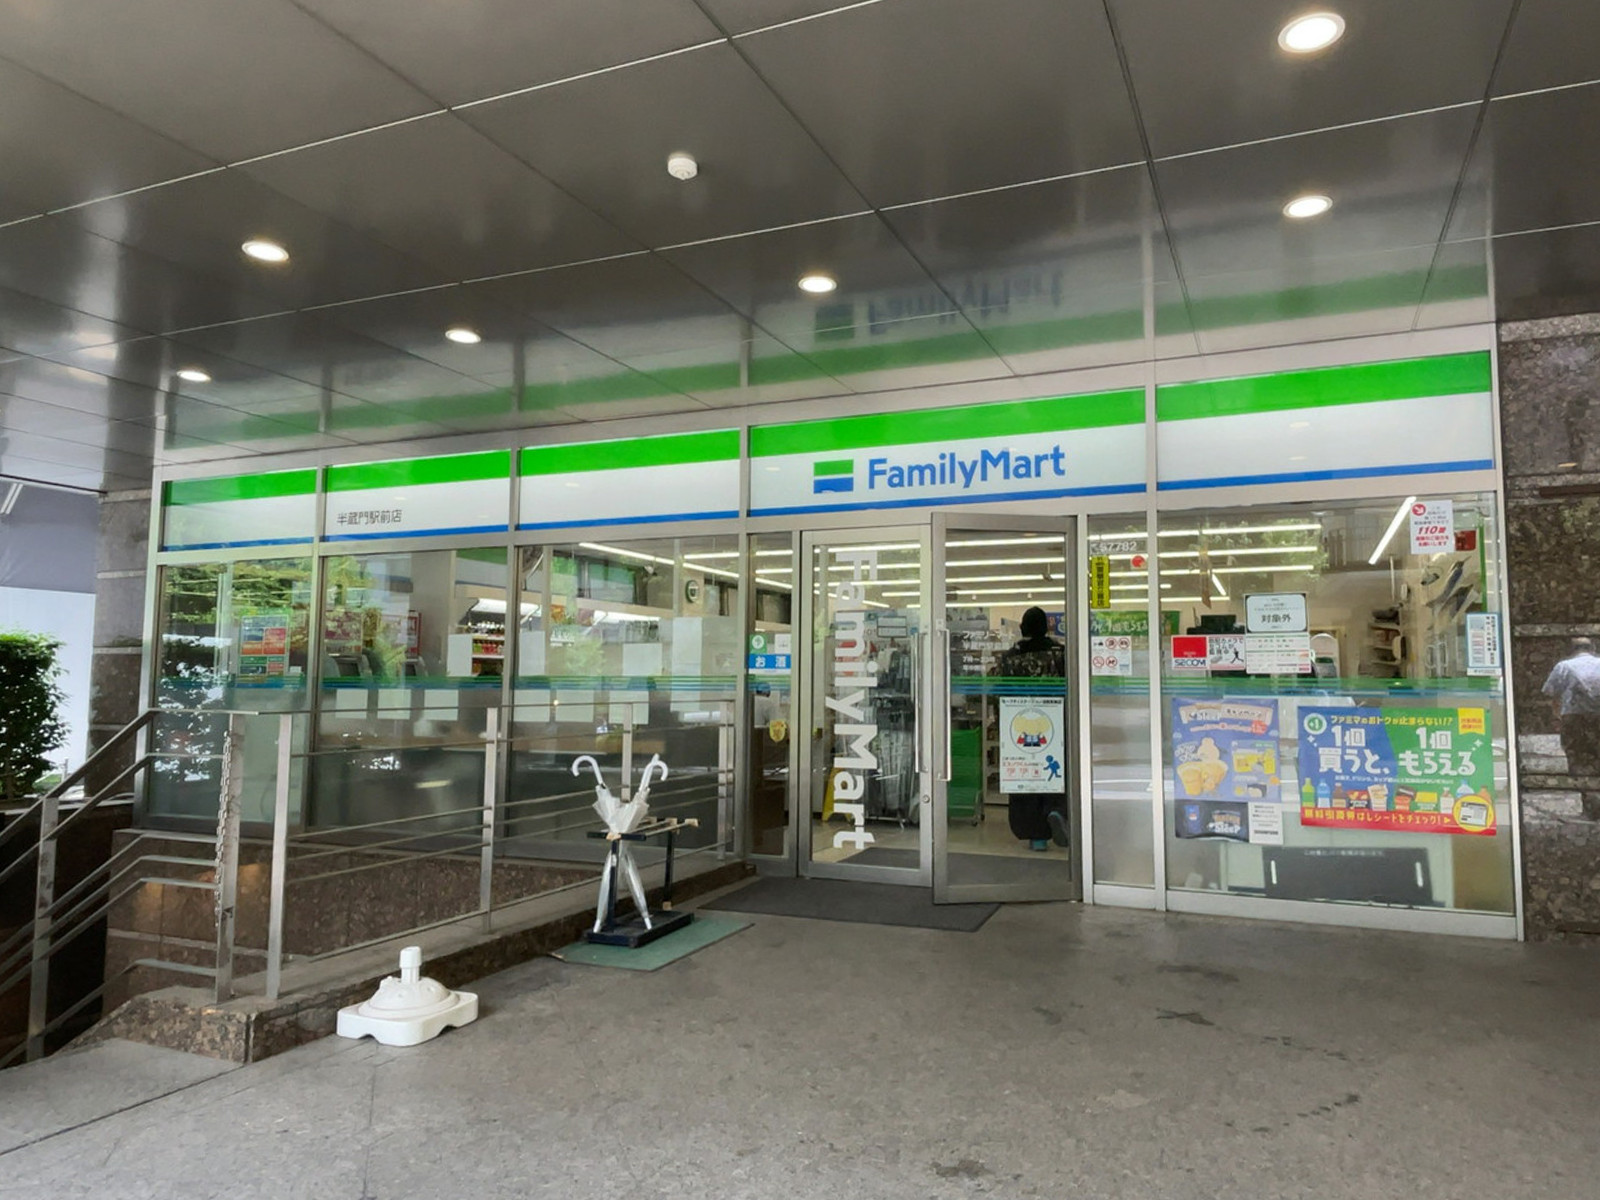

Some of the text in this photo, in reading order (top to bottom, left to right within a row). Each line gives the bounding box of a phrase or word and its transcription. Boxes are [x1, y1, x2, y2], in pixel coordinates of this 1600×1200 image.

[868, 444, 1066, 489] FamilyMart
[337, 509, 402, 526] 半蔵門駅前店
[825, 550, 878, 850] FamilyMart
[1331, 725, 1365, 747] 1個
[1416, 727, 1452, 749] 1個
[1318, 747, 1391, 775] 買うと、
[1398, 750, 1476, 776] もらえる
